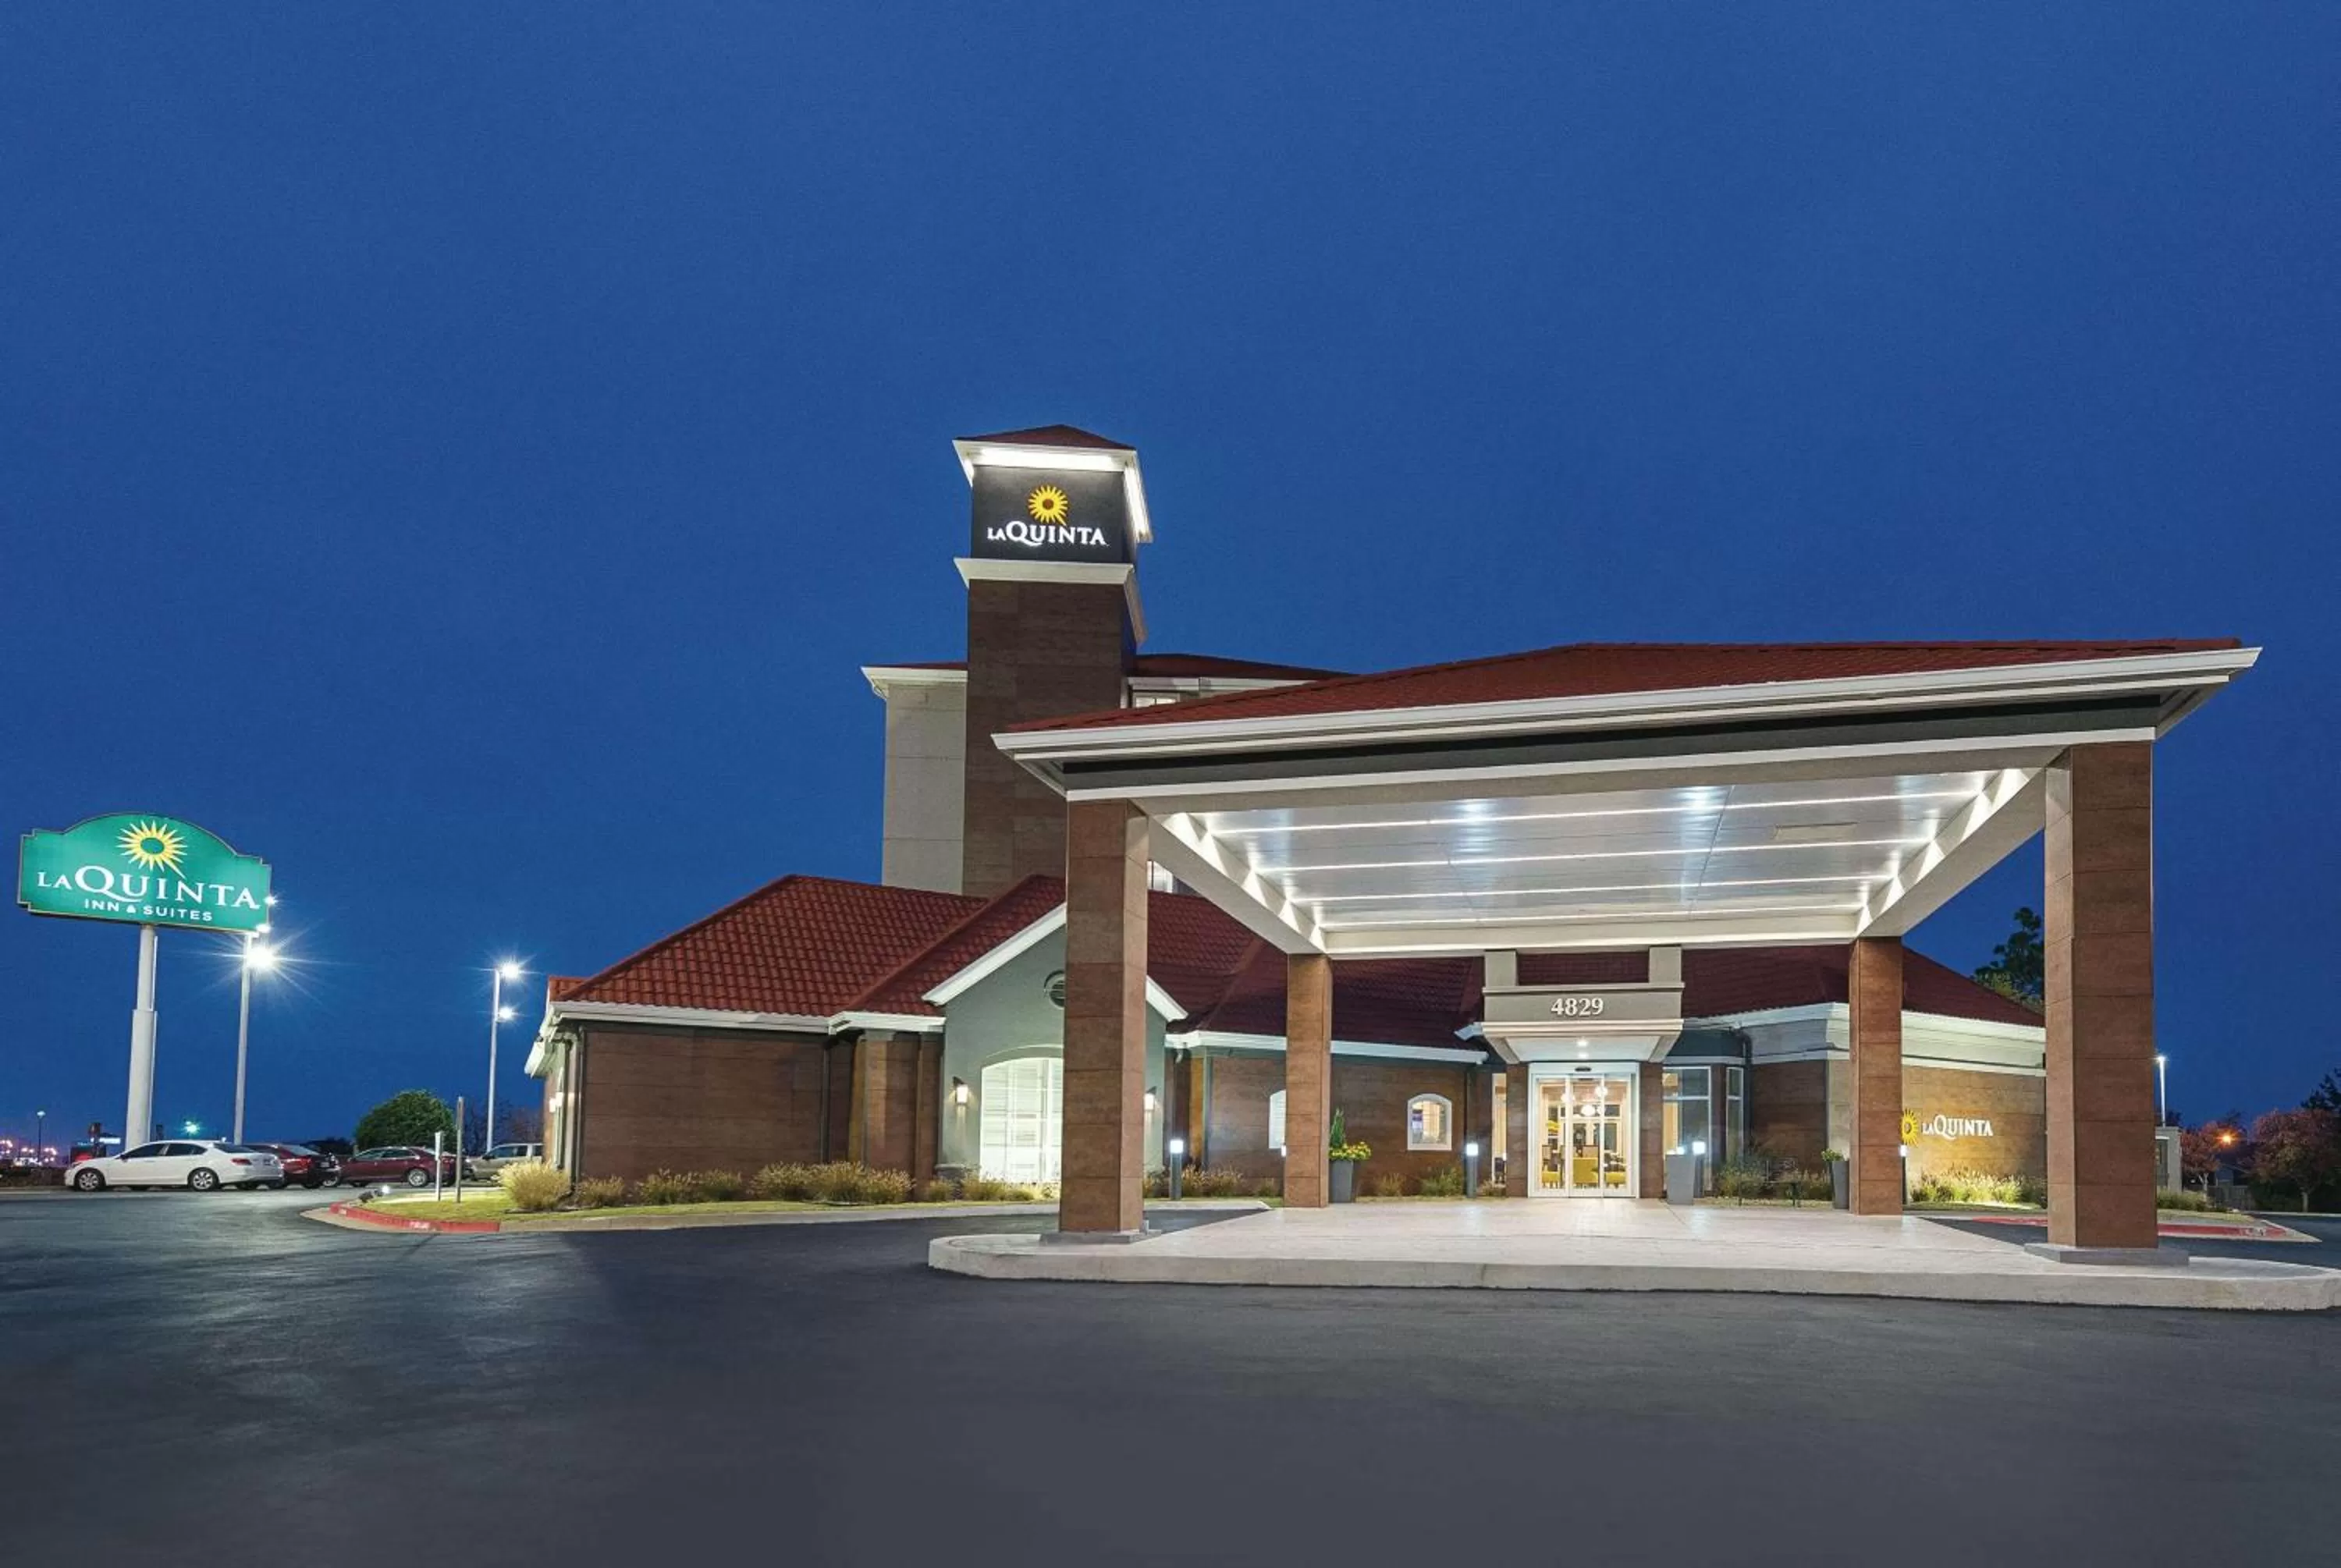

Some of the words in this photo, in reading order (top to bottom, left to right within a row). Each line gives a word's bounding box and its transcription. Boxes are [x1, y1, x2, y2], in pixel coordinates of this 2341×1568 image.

[987, 527, 1006, 541] LA
[1006, 520, 1107, 546] QUINTA
[37, 871, 72, 890] LA
[75, 865, 261, 910] QUINTA
[84, 898, 119, 912] INN
[144, 905, 213, 921] SUITES
[1551, 998, 1604, 1016] 4829
[1934, 1114, 1994, 1141] QUINTA
